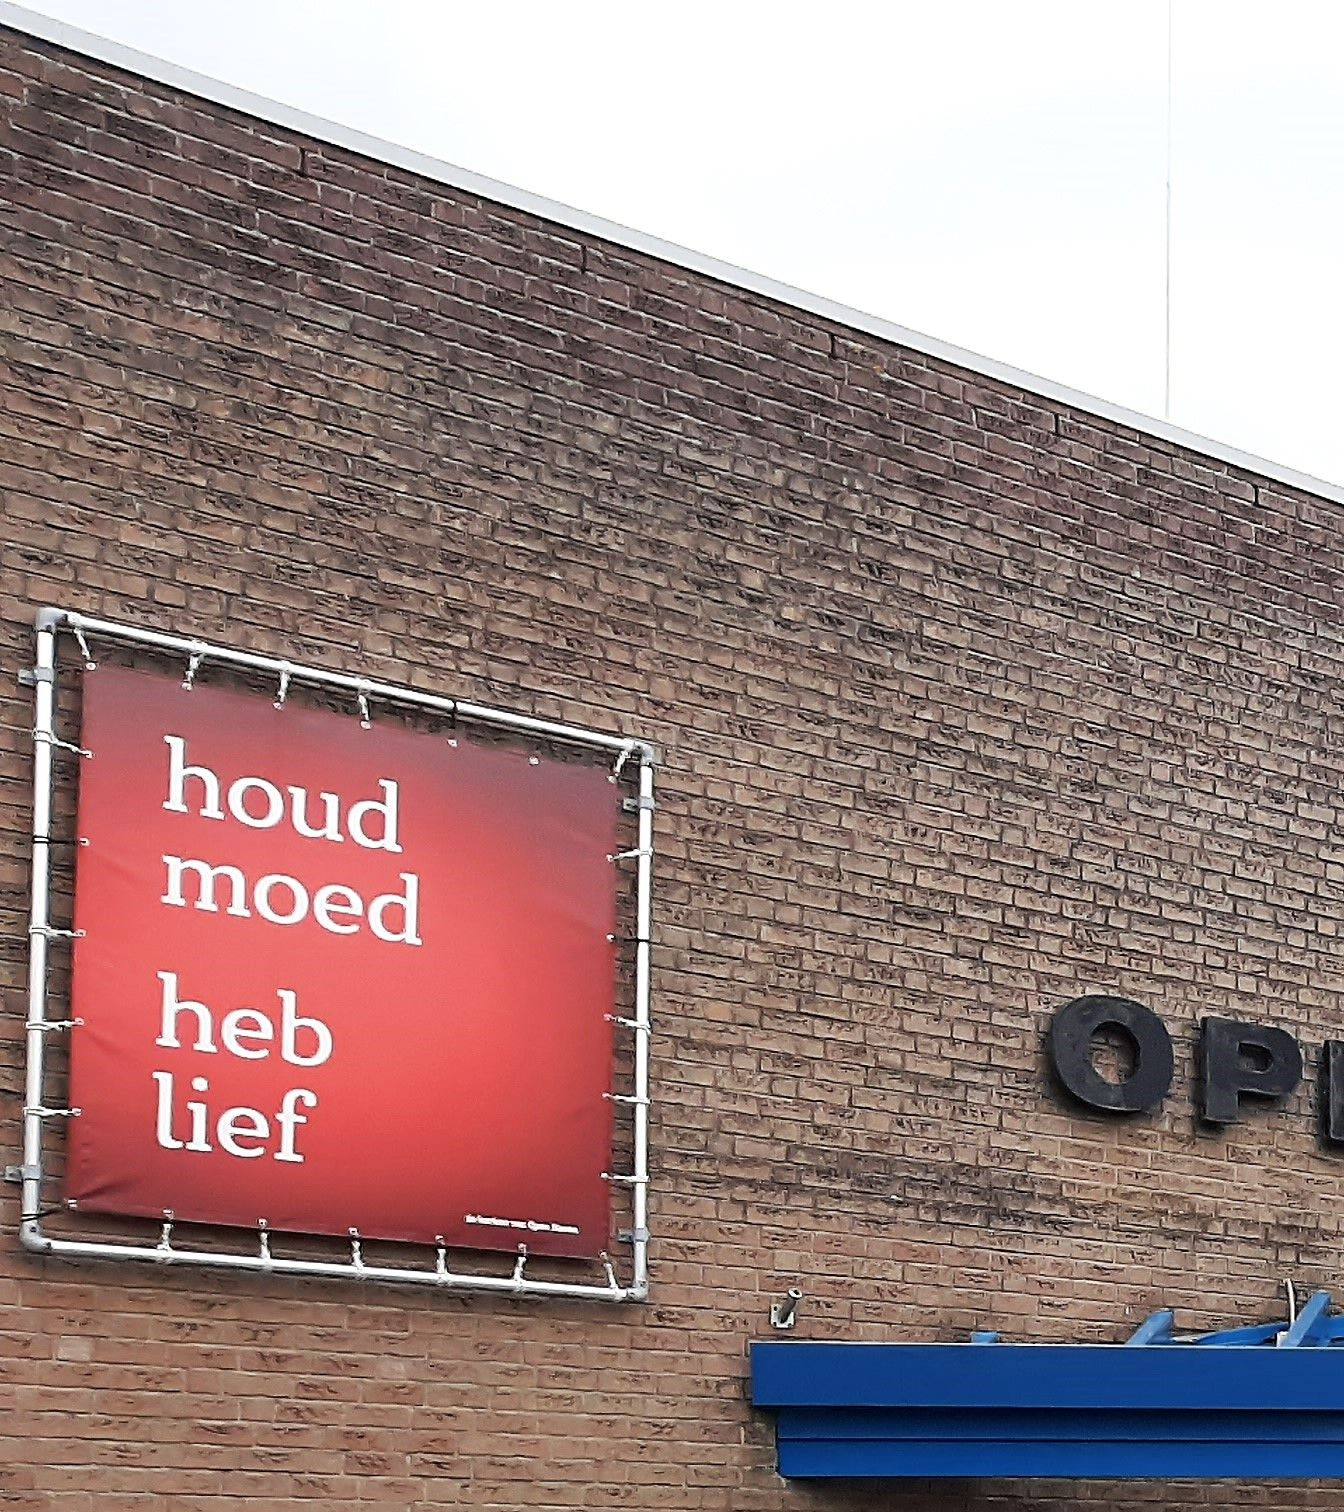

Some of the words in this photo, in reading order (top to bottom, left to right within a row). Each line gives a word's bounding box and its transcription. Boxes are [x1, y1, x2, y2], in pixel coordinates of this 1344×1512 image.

[162, 736, 403, 852] houd
[161, 854, 422, 946] moed
[156, 971, 334, 1066] heb
[152, 1072, 317, 1163] lief
